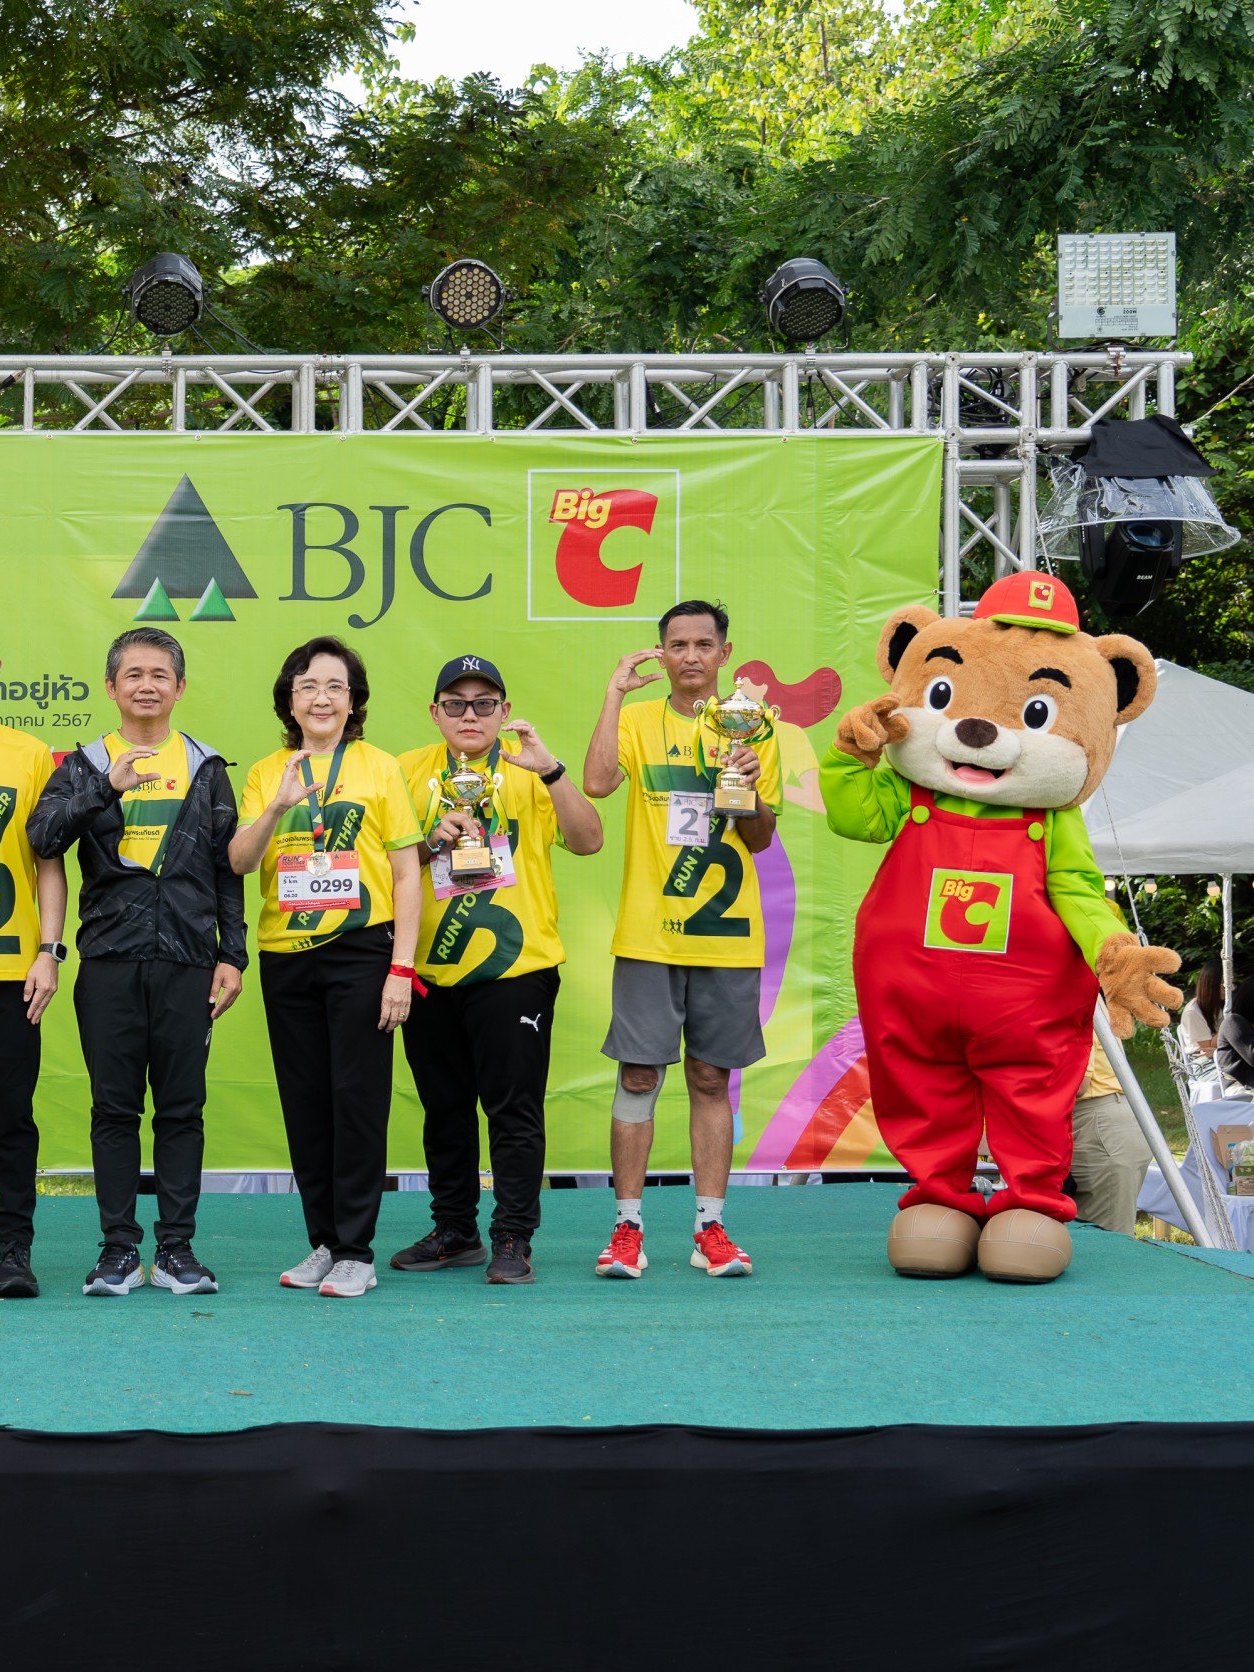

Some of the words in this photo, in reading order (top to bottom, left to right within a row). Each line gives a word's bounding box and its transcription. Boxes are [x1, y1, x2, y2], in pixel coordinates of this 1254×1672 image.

[554, 489, 614, 529] Big
[555, 489, 659, 607] C
[277, 502, 493, 630] BJC
[51, 713, 92, 727] 2567
[142, 781, 162, 793] BJC
[678, 807, 699, 836] 2
[310, 879, 353, 894] 0299
[673, 855, 698, 892] RUN
[942, 880, 975, 902] Big
[436, 918, 463, 960] RUN
